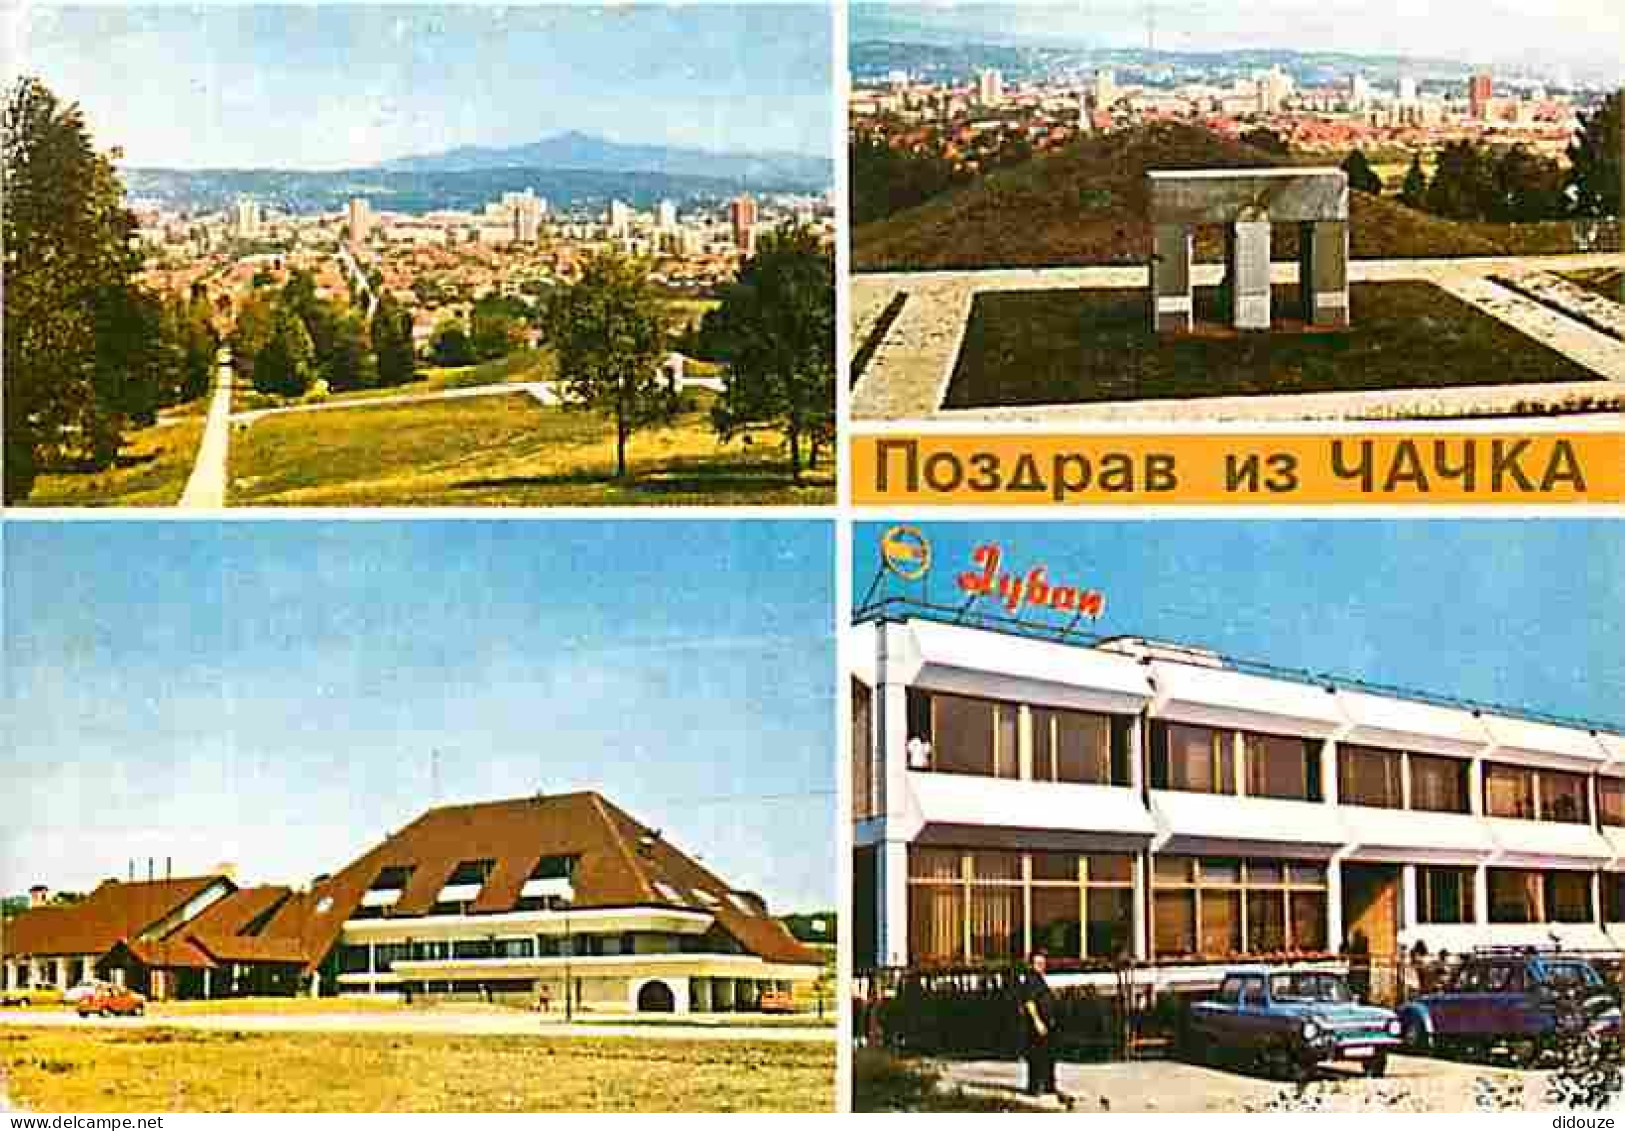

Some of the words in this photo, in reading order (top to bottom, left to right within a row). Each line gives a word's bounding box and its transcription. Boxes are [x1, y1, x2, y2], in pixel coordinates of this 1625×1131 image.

[875, 438, 1179, 502] Поздрав
[1225, 452, 1299, 493] из
[1330, 438, 1588, 494] ЧАЧКА
